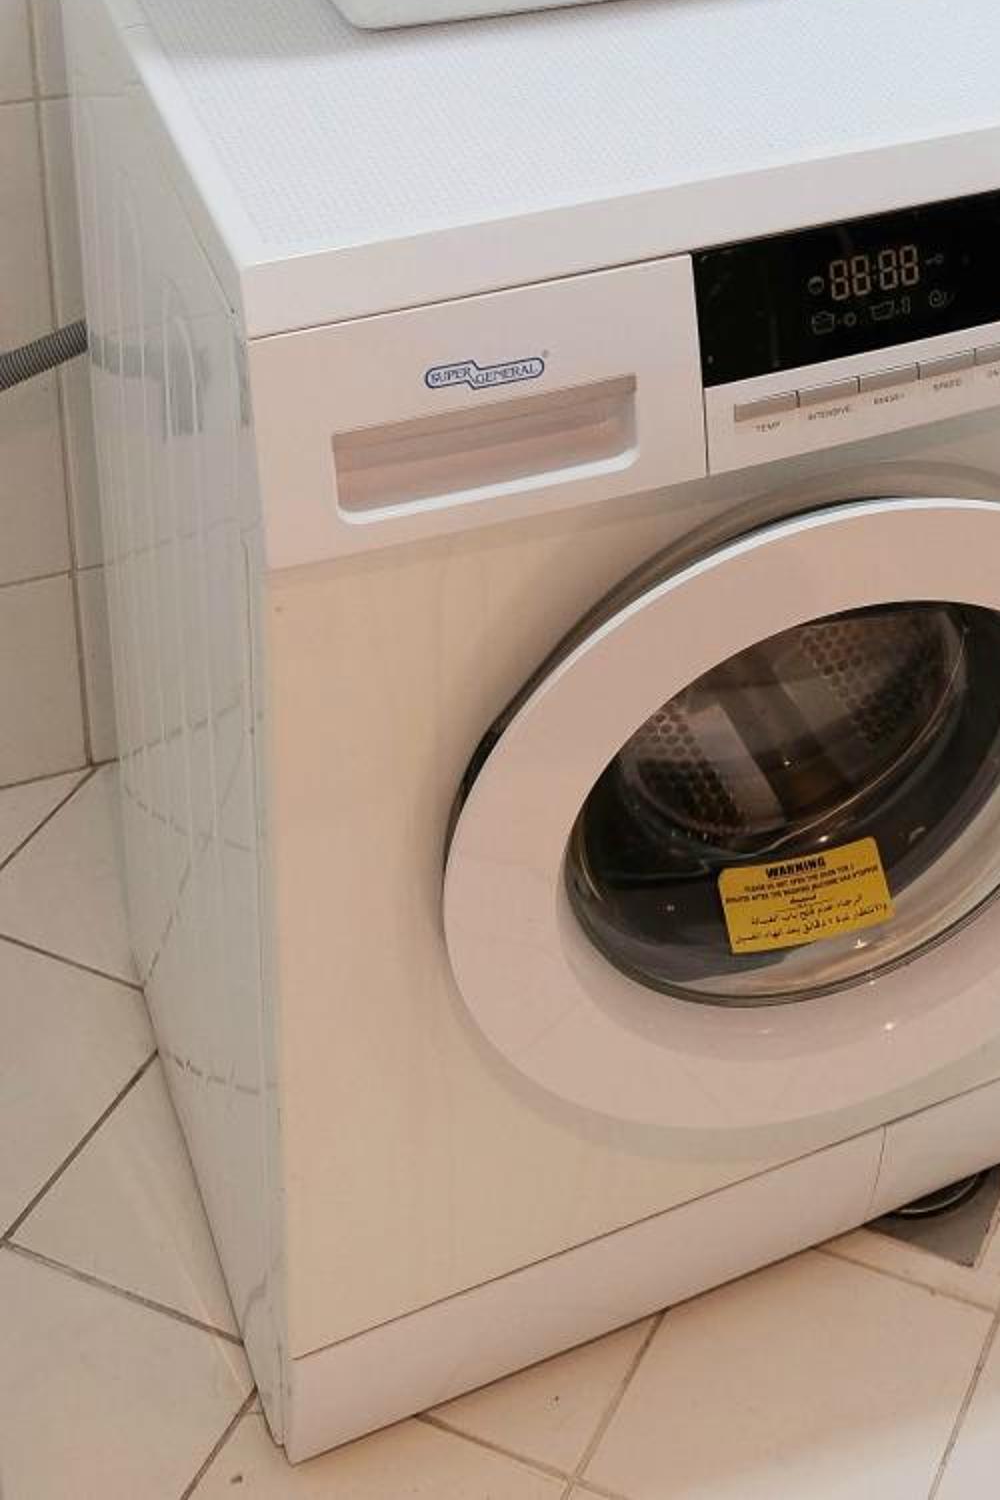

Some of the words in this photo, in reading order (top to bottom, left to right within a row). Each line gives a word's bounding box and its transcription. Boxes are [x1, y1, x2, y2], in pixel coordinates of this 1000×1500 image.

[431, 367, 471, 384] SUPER
[474, 363, 538, 385] GENERAL
[765, 856, 826, 879] WARNING
